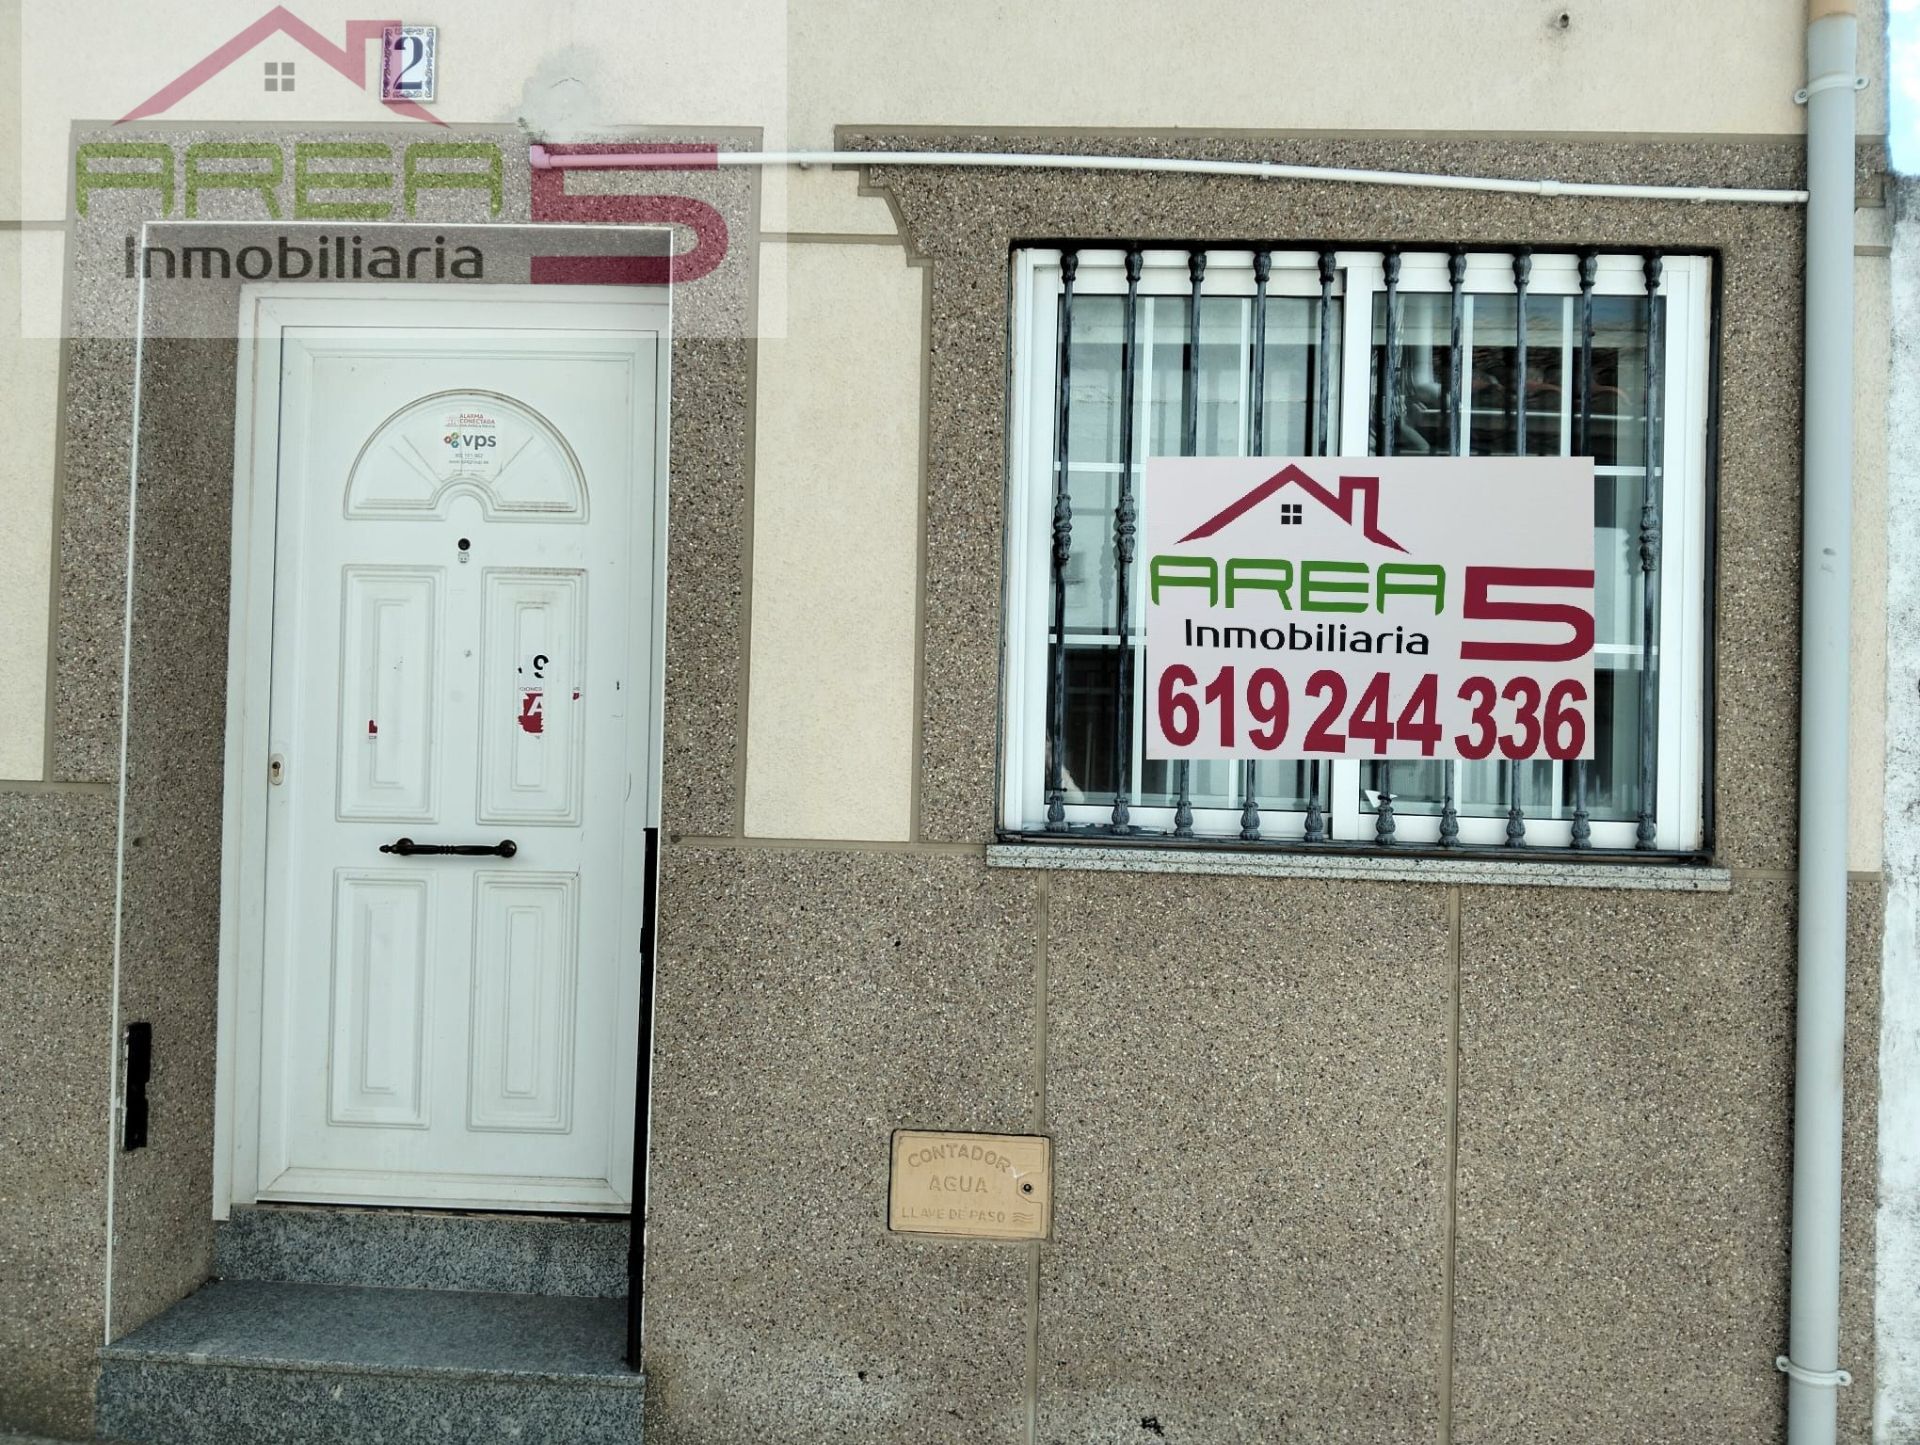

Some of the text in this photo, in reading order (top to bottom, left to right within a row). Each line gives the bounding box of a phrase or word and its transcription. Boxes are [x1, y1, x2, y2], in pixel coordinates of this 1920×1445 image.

[393, 36, 423, 90] 2
[462, 434, 497, 450] vps
[1150, 554, 1595, 662] AREA 5
[1184, 618, 1430, 655] Inmobiliaria
[1158, 663, 1588, 760] 619 244 336
[907, 1143, 1011, 1173] CONTADOR
[929, 1174, 989, 1193] AGUA
[901, 1208, 1006, 1223] LLAVE DE PASO
